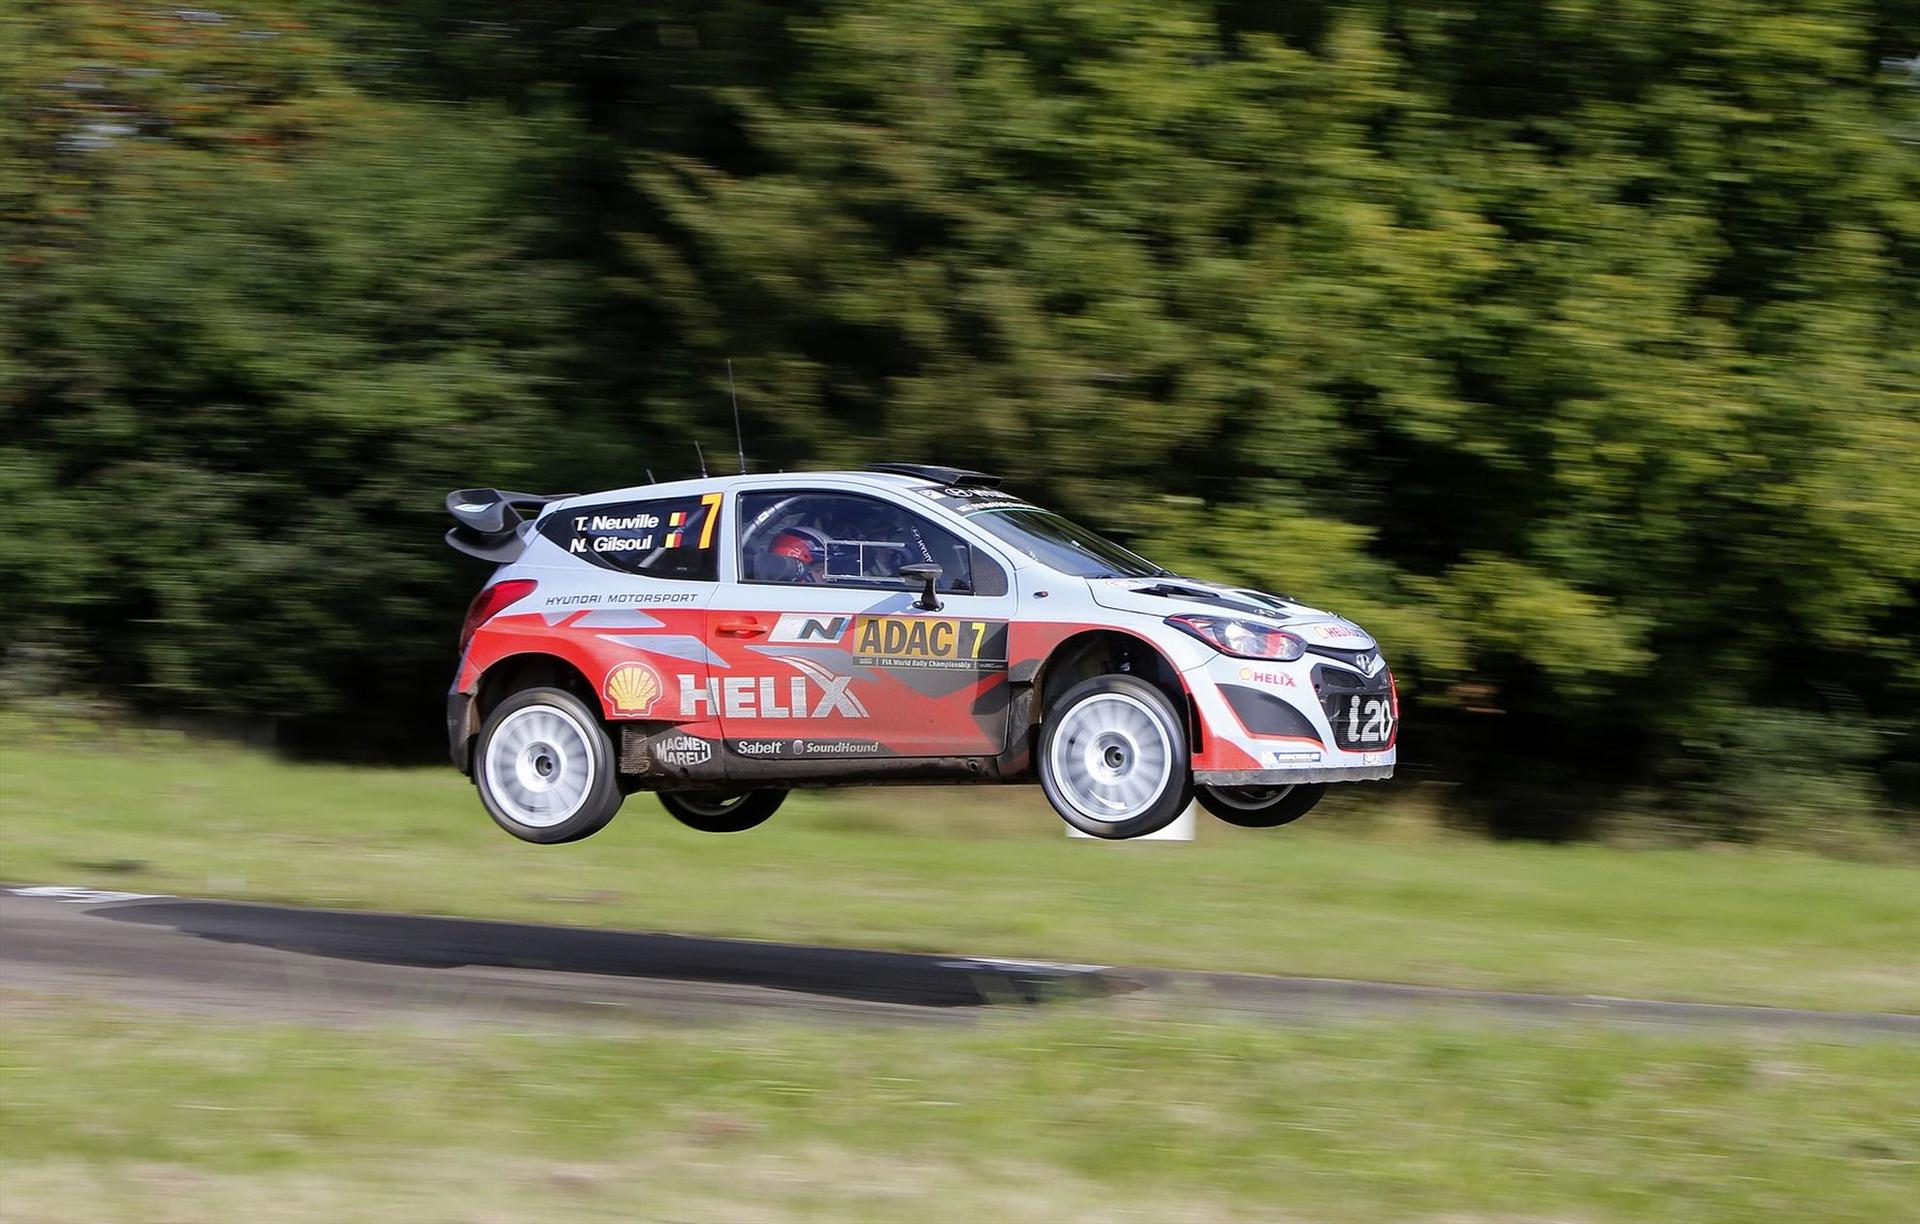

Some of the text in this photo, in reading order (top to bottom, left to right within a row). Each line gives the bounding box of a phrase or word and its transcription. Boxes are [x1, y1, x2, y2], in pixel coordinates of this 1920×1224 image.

[575, 513, 660, 531] T. Neuville
[699, 492, 724, 550] 7
[570, 535, 653, 553] N. Gilsoul
[546, 593, 698, 605] HYUNDAI MOTORSPORT
[859, 619, 953, 657] ADAC
[971, 622, 986, 658] 7
[912, 660, 927, 668] Rally
[928, 660, 972, 669] Championship
[1253, 671, 1297, 687] HELIX
[677, 670, 870, 718] HELIX
[1347, 695, 1393, 742] i20
[656, 736, 711, 751] MAGNETI
[738, 741, 878, 754] Sabelt SoundHound
[657, 750, 711, 766] MARELLI
